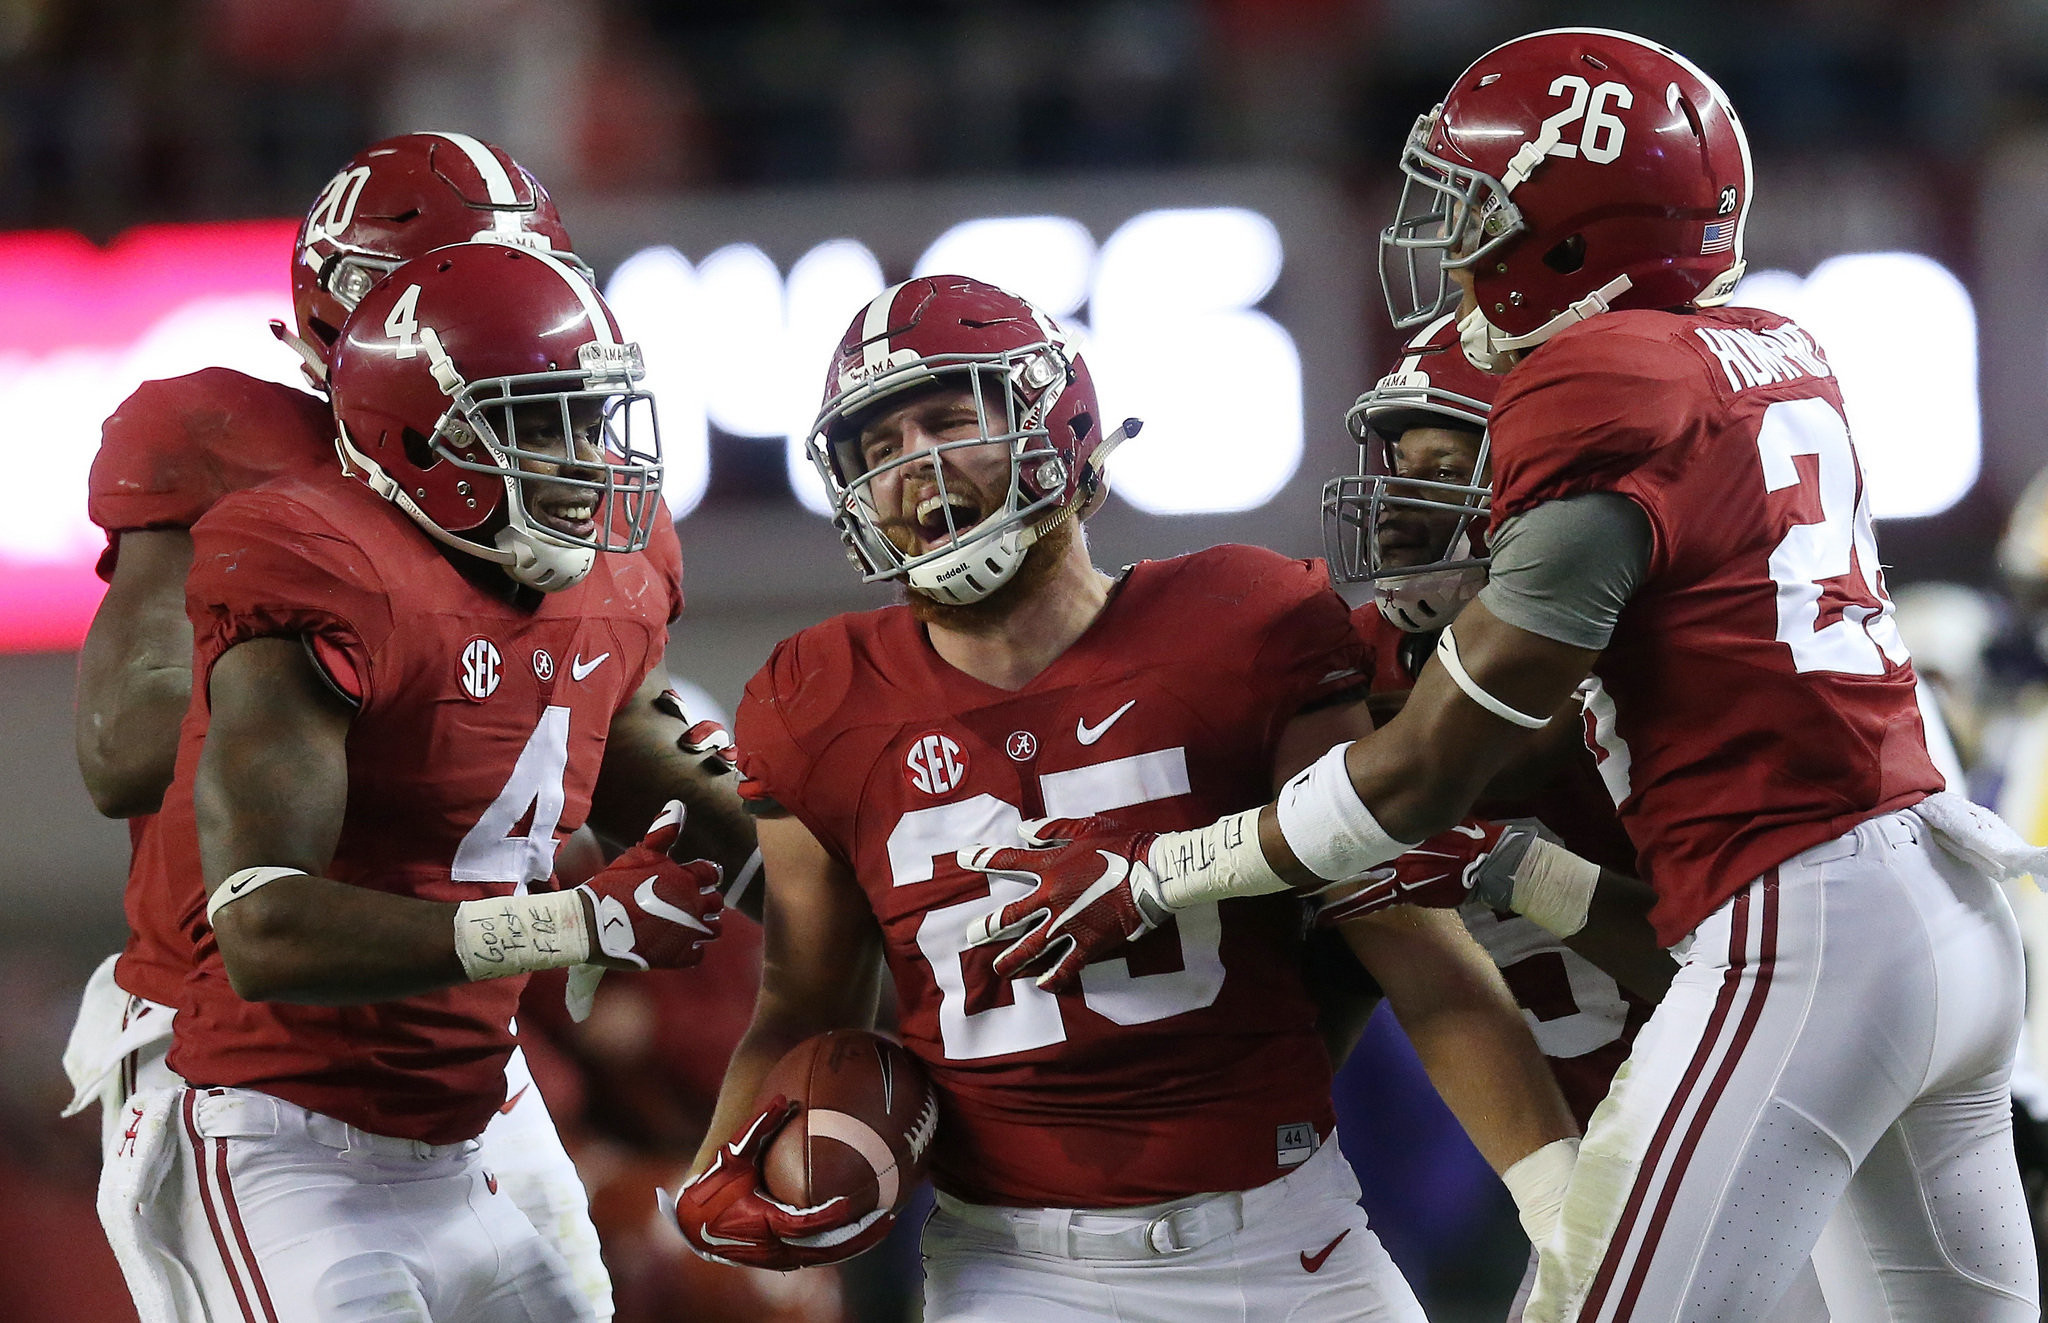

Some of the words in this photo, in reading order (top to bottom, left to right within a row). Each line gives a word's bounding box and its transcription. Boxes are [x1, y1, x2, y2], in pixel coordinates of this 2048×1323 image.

[1540, 75, 1634, 165] 26
[305, 166, 371, 247] 20
[1719, 188, 1736, 214] 28
[384, 283, 422, 359] 4
[936, 562, 968, 583] Riddell
[461, 639, 501, 698] SEC
[451, 705, 571, 882] 4
[906, 734, 964, 794] SEC
[886, 746, 1226, 1060] 25
[471, 917, 504, 963] God
[1285, 1130, 1302, 1145] 44
